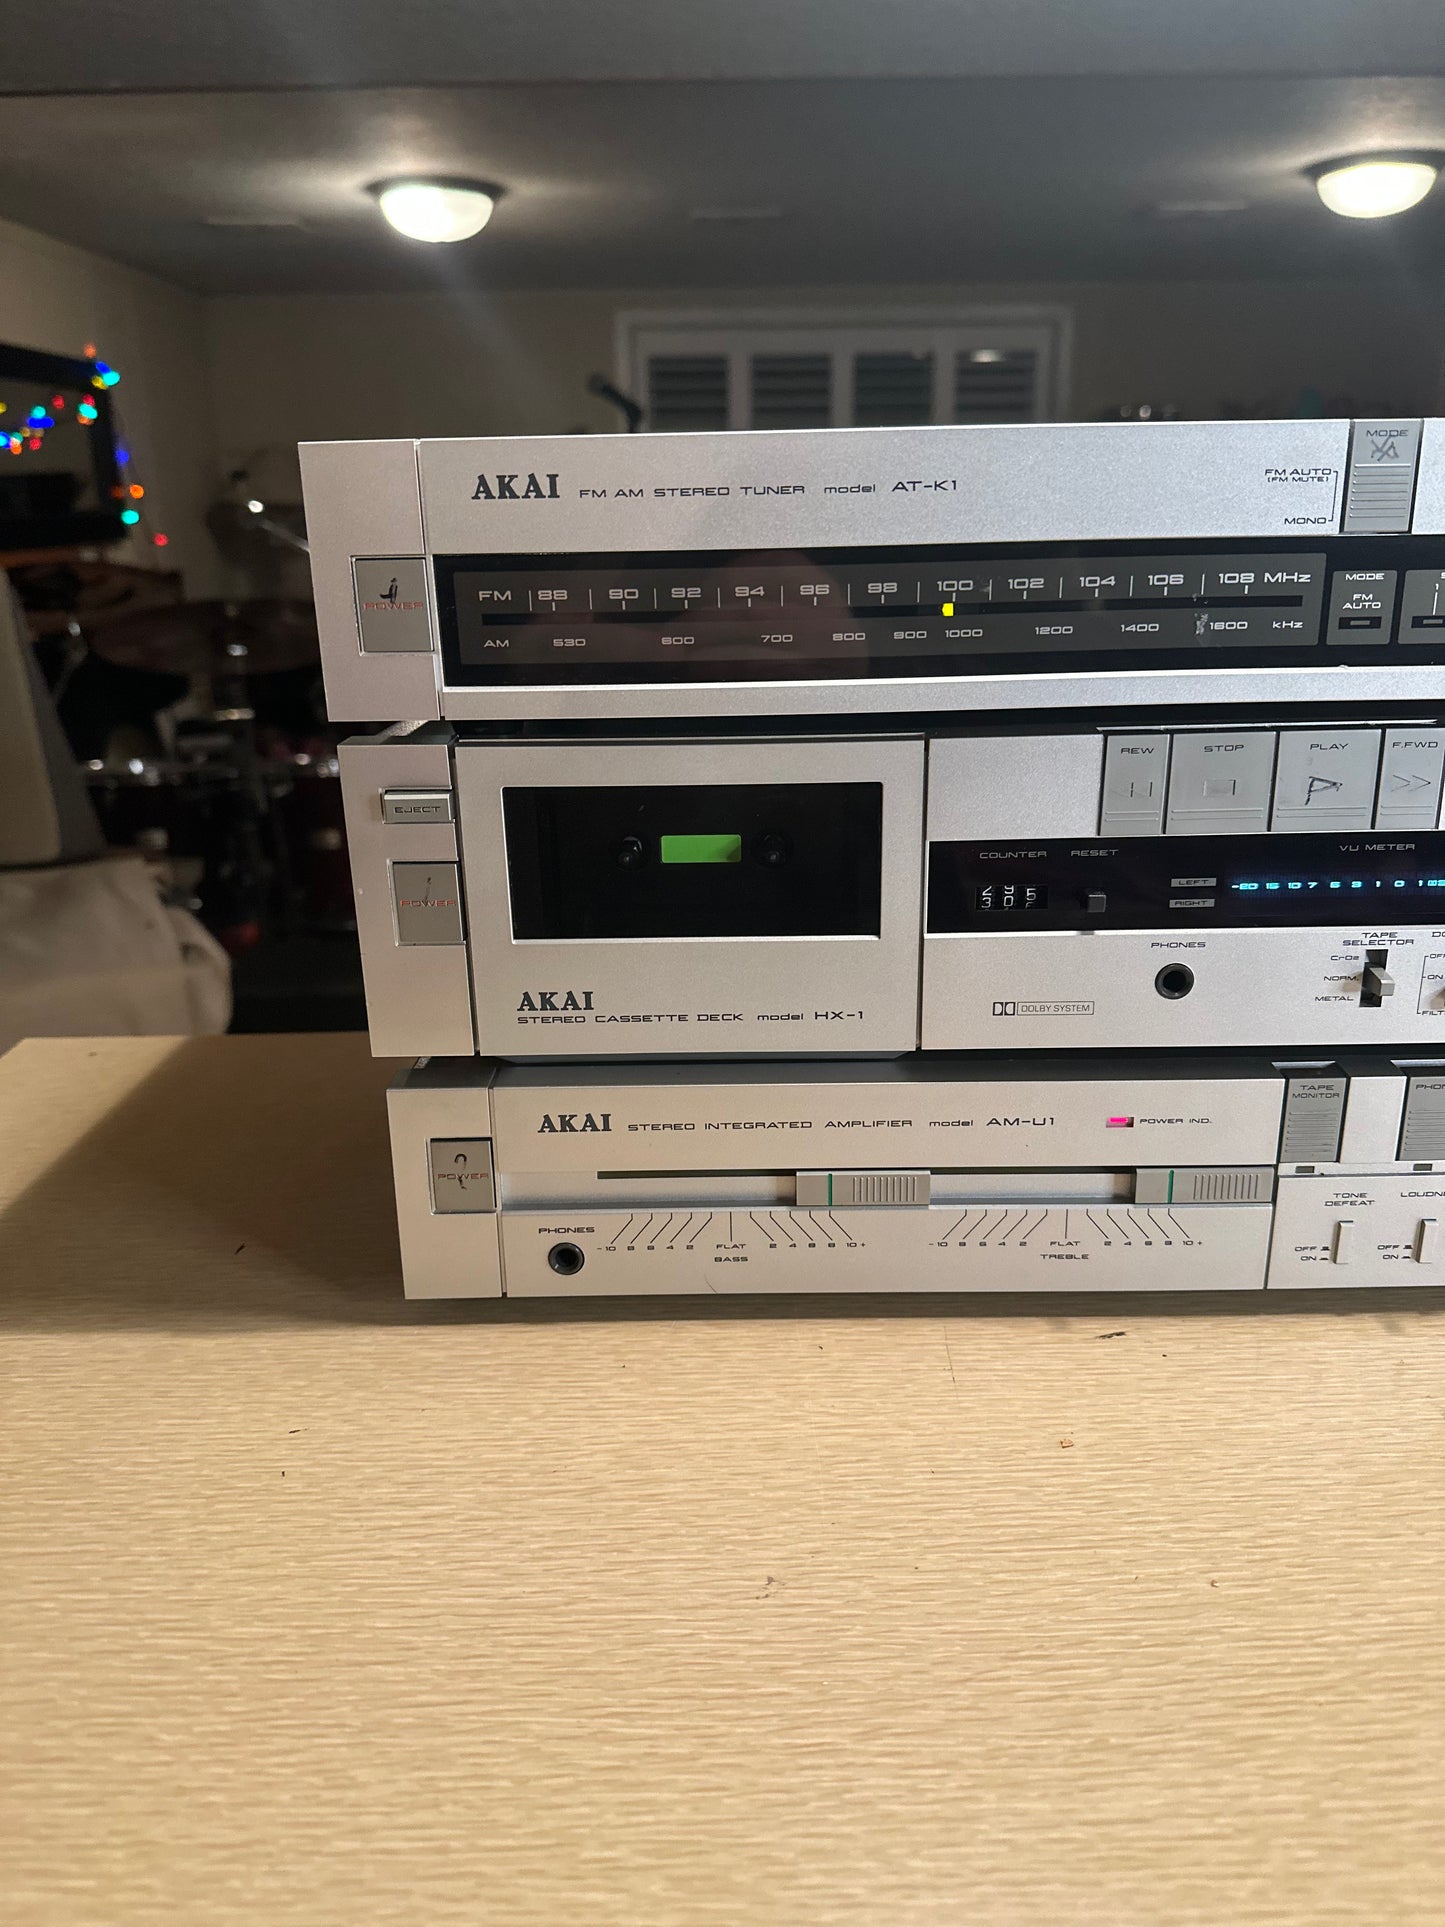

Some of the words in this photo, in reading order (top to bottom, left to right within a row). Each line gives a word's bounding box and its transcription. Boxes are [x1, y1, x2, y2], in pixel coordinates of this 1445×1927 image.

[1366, 429, 1409, 437] MODE
[1264, 468, 1287, 476] FM
[1290, 468, 1332, 476] AUTO
[471, 473, 561, 501] AKAI
[579, 488, 608, 499] FM
[615, 487, 645, 498] AM
[654, 485, 731, 498] STEREO
[740, 484, 806, 497] TUNER
[824, 482, 877, 495] model
[892, 479, 959, 492] AT-K1
[1283, 517, 1327, 525] MONO
[1345, 572, 1385, 581] MODE
[478, 589, 512, 602] FM
[537, 588, 568, 600] 88
[608, 588, 639, 600] 90
[671, 587, 702, 599] 92
[735, 585, 766, 597] 94
[799, 584, 831, 596] 96
[867, 582, 898, 594] 98
[936, 579, 974, 592] 100
[1007, 577, 1045, 590] 102
[1079, 575, 1117, 588] 104
[1147, 574, 1185, 586] 106
[1218, 572, 1256, 584] 108
[1264, 571, 1312, 584] MHz
[1353, 593, 1374, 601] FM
[363, 601, 424, 610] POWER
[1342, 601, 1382, 609] AUTO
[483, 638, 510, 649] AM
[553, 637, 587, 647] 530
[661, 635, 695, 646] 600
[760, 633, 794, 644] 700
[832, 631, 866, 642] 800
[893, 629, 928, 640] 900
[945, 627, 983, 639] 1000
[1034, 624, 1074, 636] 1200
[1120, 622, 1160, 634] 1400
[1209, 620, 1249, 631] 1600
[1272, 619, 1303, 631] kHz
[1204, 744, 1245, 753] STOP
[1310, 742, 1349, 751] PLAY
[1392, 740, 1439, 749] F.FWD
[1120, 746, 1155, 755] REW
[394, 806, 441, 814] EJECT
[1364, 843, 1416, 851] METER
[979, 851, 1048, 860] COUNTER
[1070, 849, 1119, 857] RESET
[1177, 879, 1210, 887] LEFT
[1375, 880, 1382, 888] 1
[400, 899, 457, 907] POWER
[1173, 900, 1208, 908] RIGHT
[1361, 931, 1398, 939] TAPE
[1150, 941, 1206, 949] PHONES
[1342, 938, 1414, 946] SELECTOR
[516, 990, 595, 1012] AKAI
[1021, 1004, 1051, 1013] DOLBY
[1053, 1003, 1090, 1012] SYSTEM
[517, 1013, 587, 1024] STEREO
[594, 1012, 690, 1023] CASSETTE
[697, 1012, 744, 1022] DECK
[756, 1011, 805, 1022] model
[814, 1010, 865, 1021] HX-1
[537, 1112, 612, 1134] AKAI
[627, 1122, 696, 1132] STEREO
[703, 1120, 813, 1131] INTEGRATED
[824, 1119, 914, 1130] AMPLIFIER
[928, 1118, 974, 1128] model
[986, 1116, 1056, 1127] AM-U1
[437, 1172, 489, 1180] POWER
[1323, 1199, 1375, 1207] DEFEAT
[538, 1226, 596, 1235] PHONES
